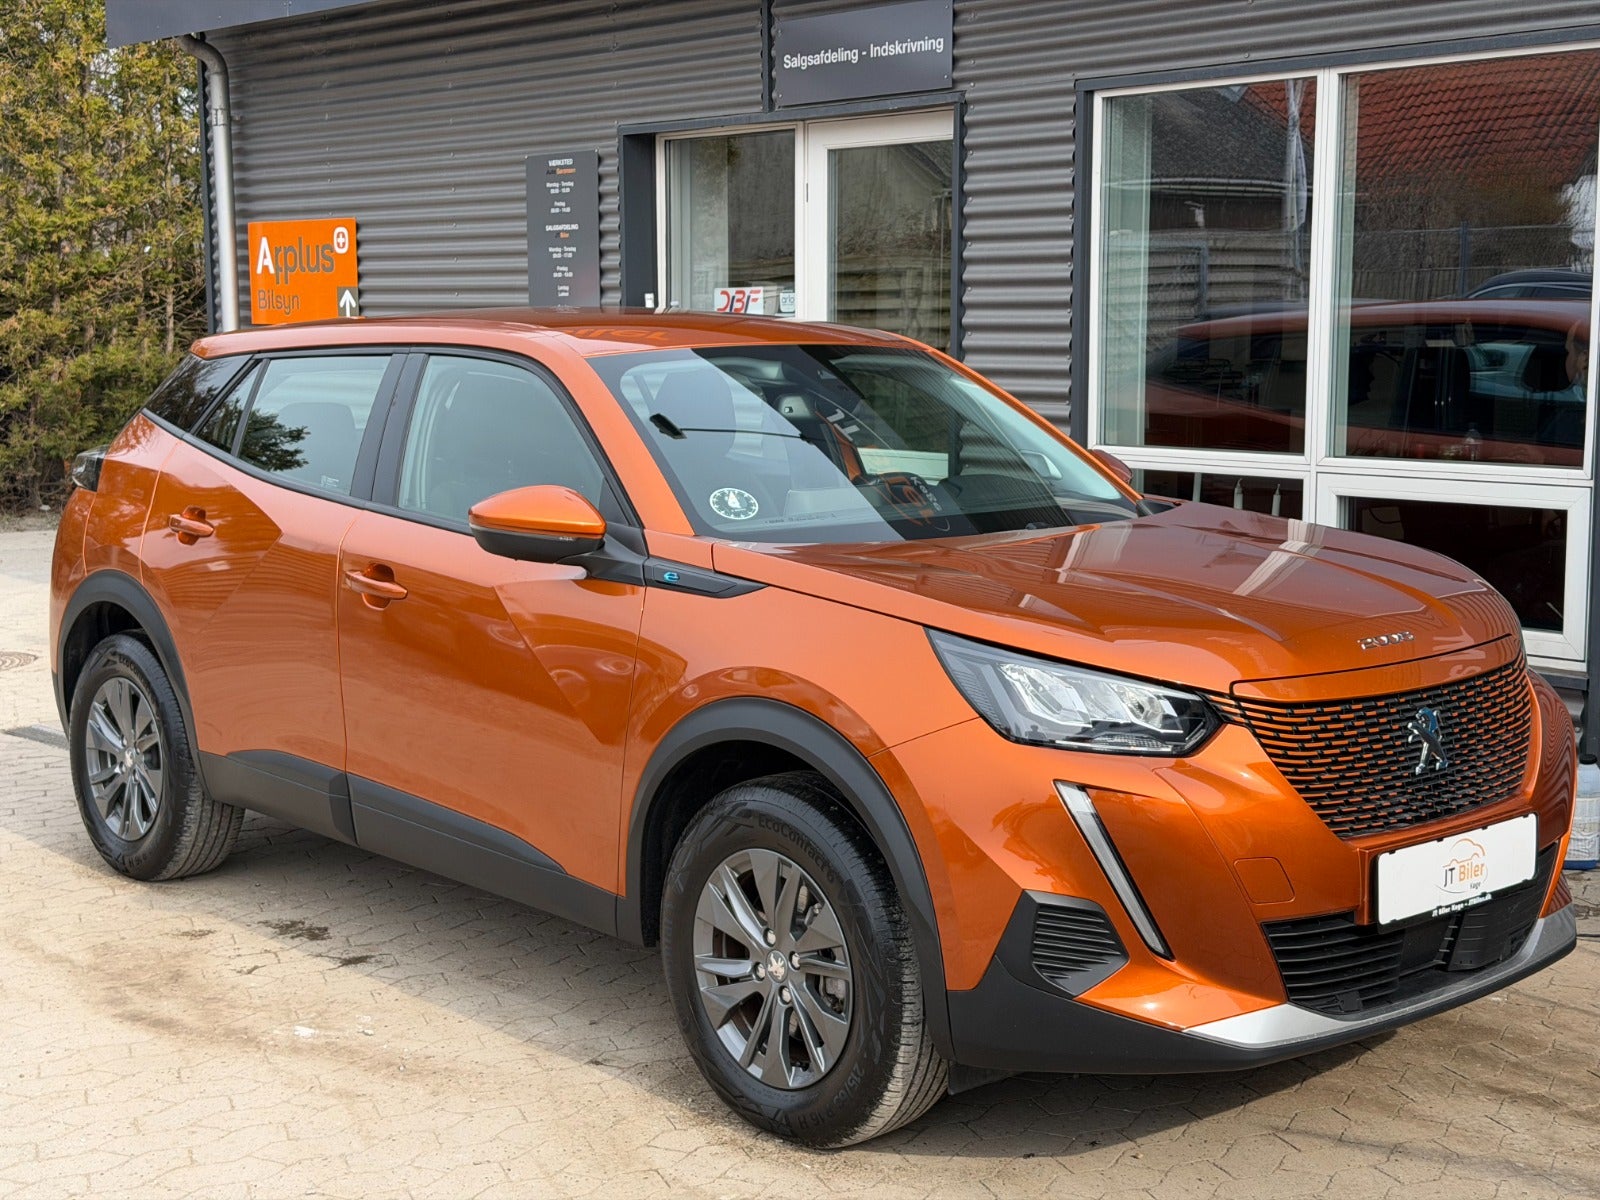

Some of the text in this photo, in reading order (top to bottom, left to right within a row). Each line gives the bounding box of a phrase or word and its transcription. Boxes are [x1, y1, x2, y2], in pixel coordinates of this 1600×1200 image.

[783, 48, 859, 70] Salgsafdeling
[870, 36, 944, 58] Indskrivning
[258, 289, 300, 316] Bilsyn
[1443, 861, 1485, 888] JT Biler
